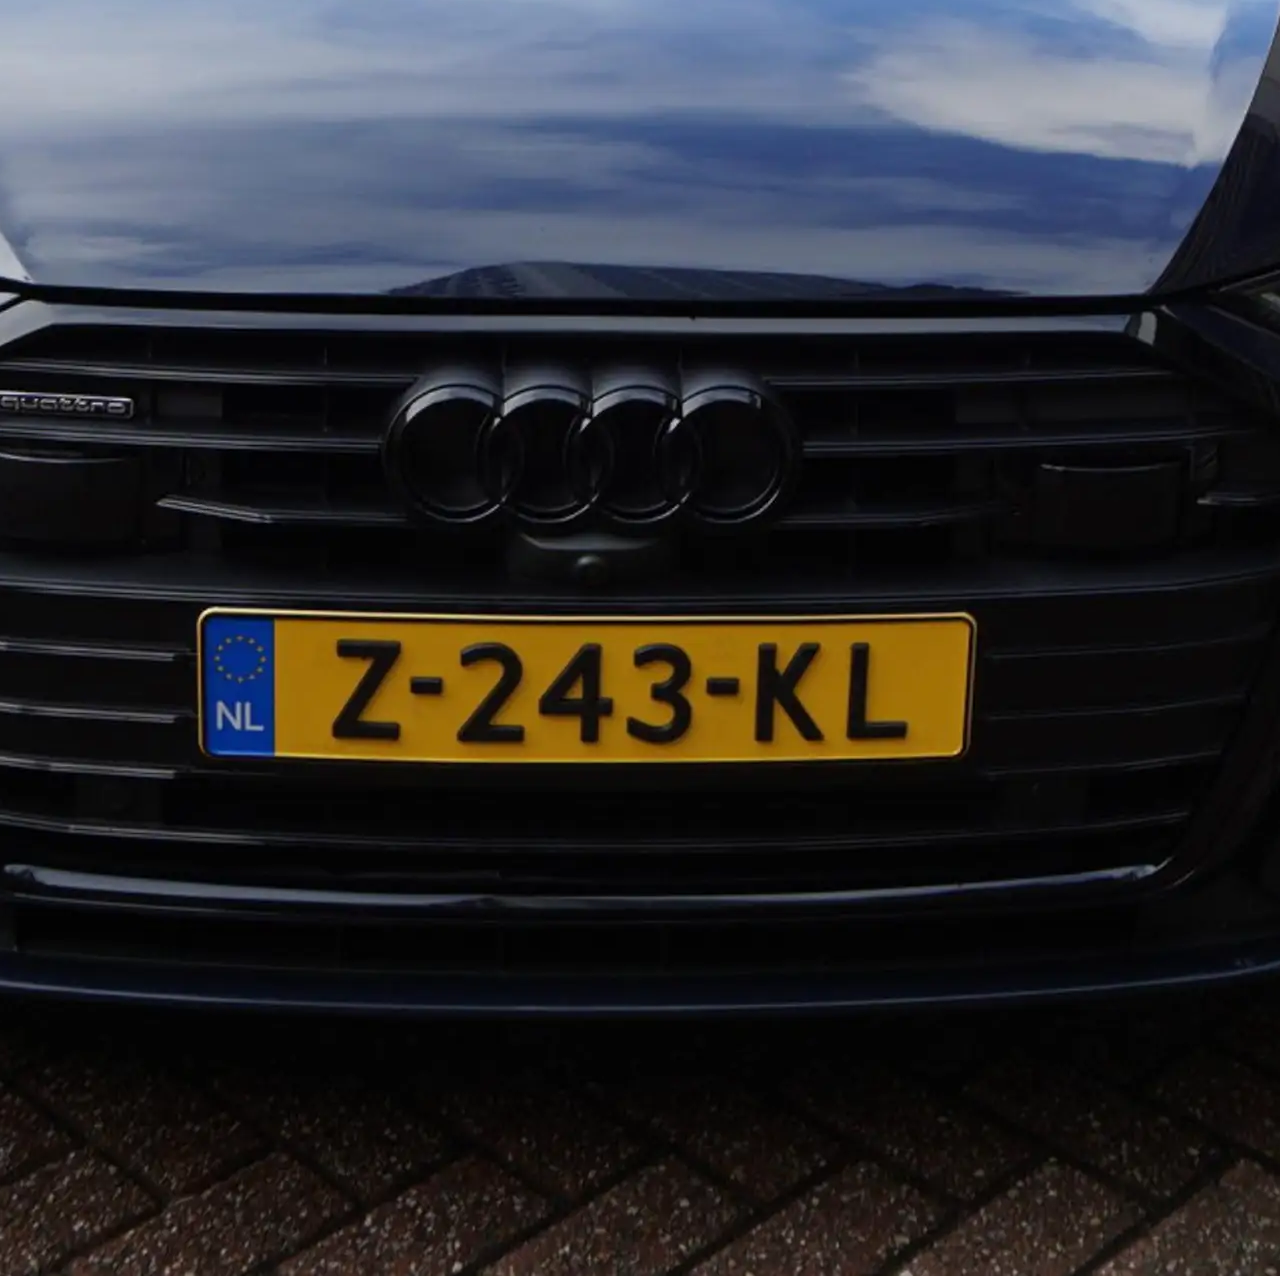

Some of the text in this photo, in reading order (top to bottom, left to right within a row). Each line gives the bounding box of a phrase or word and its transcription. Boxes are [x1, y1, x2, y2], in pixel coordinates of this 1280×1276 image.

[0, 395, 126, 414] quattro
[215, 638, 909, 744] NL Z-243-KL
